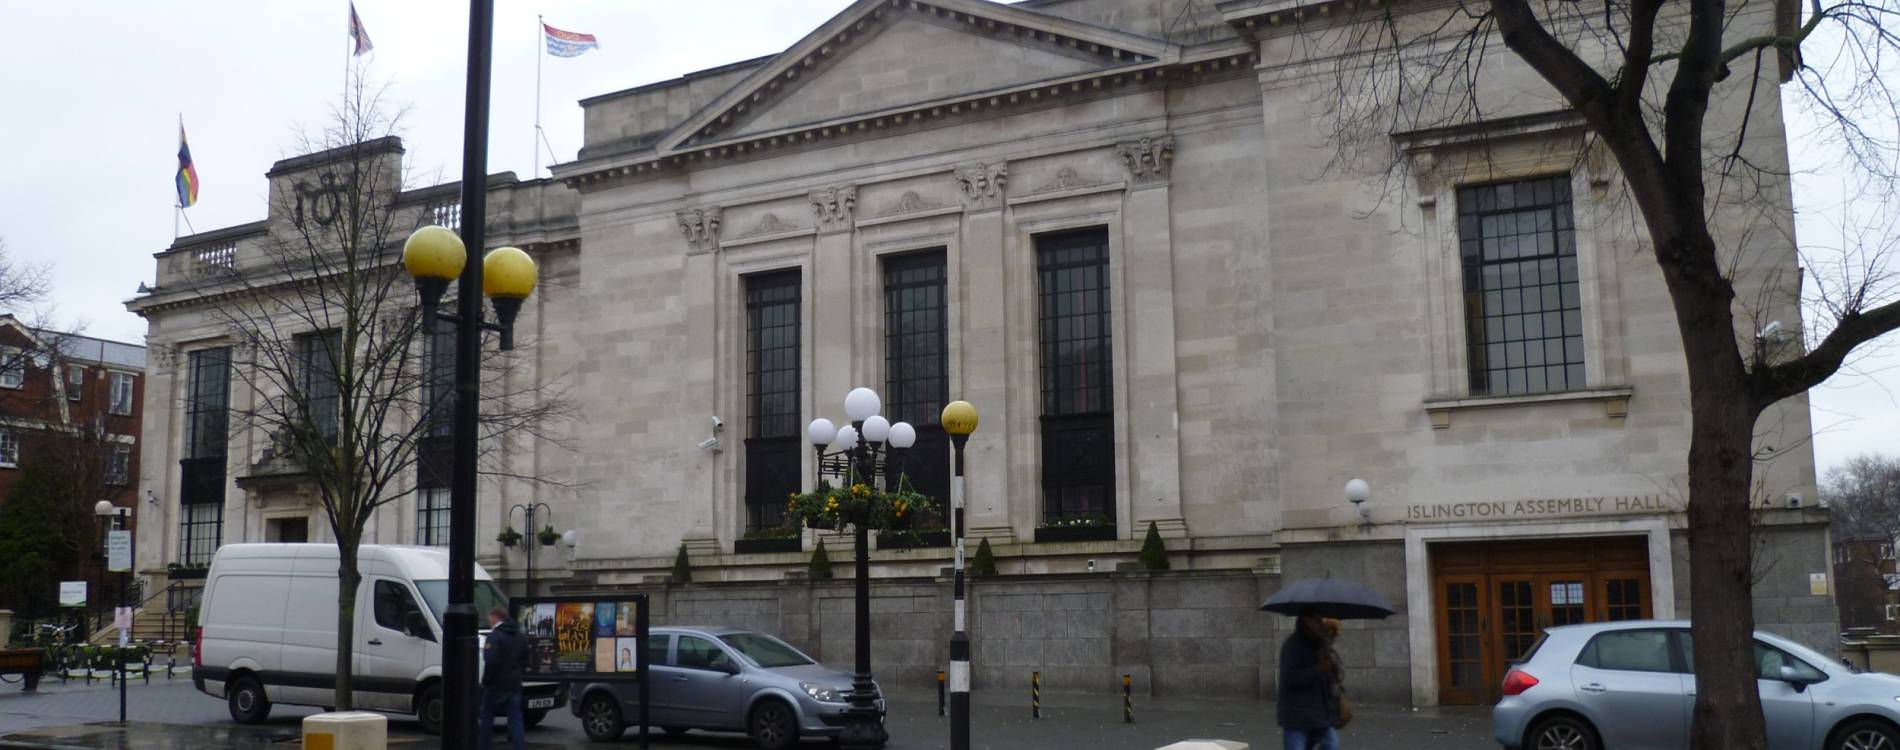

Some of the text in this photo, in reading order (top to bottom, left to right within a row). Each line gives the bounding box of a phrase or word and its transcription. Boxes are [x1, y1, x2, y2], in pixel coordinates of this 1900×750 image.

[1407, 495, 1666, 520] ISLINGTON ASSEMBLY HALL
[567, 630, 589, 641] LAST
[559, 640, 590, 652] WALTZ
